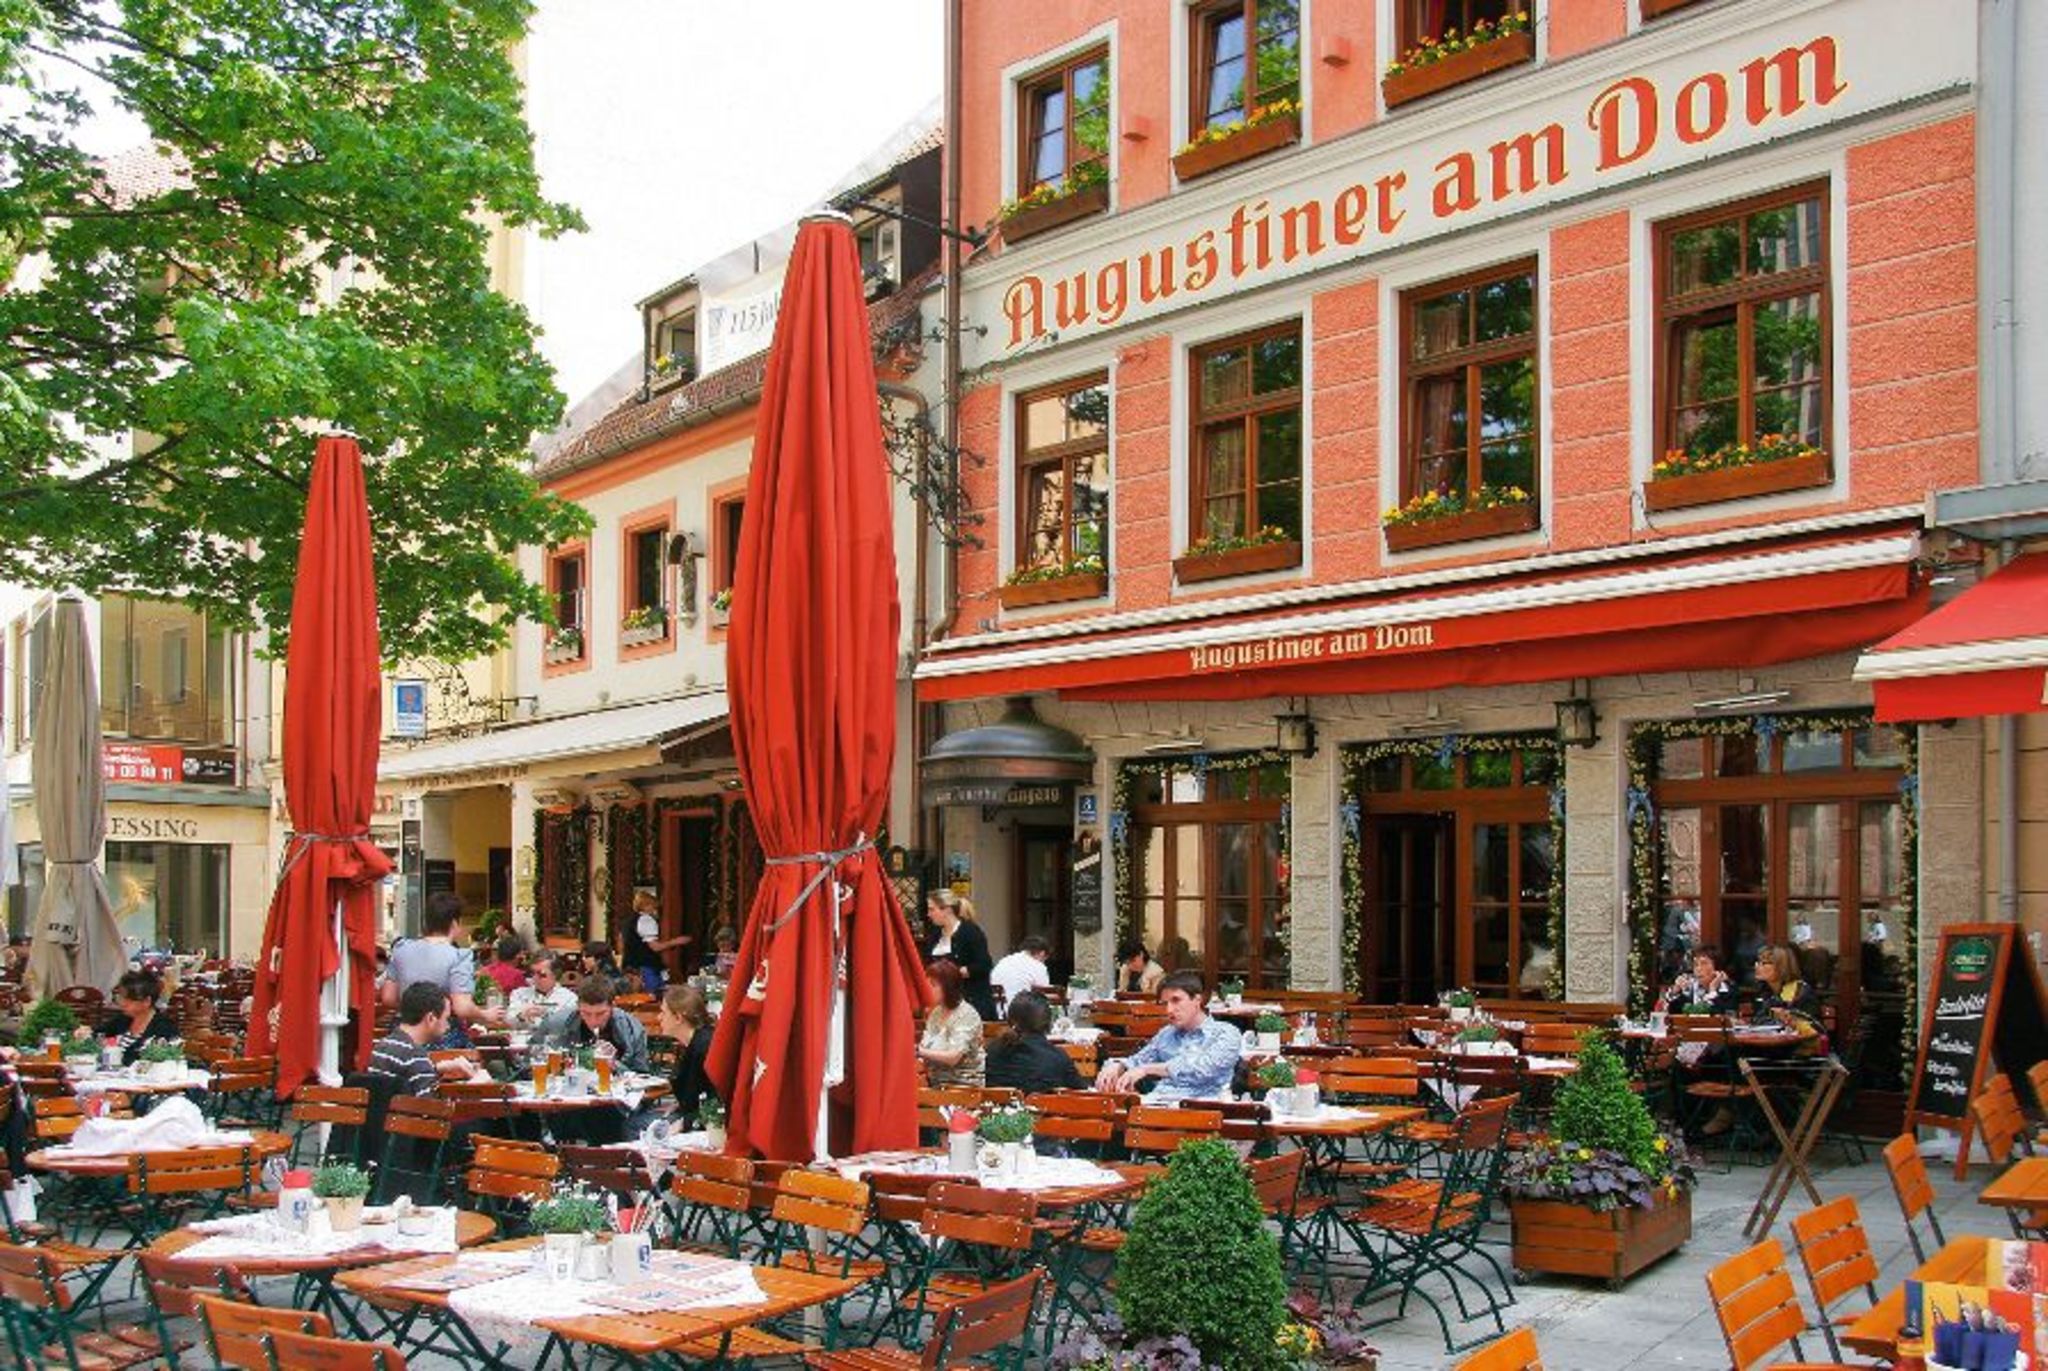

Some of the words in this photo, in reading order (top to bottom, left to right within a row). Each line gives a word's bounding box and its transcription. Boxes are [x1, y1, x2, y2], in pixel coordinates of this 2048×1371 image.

[1003, 170, 1407, 348] Augustiner
[1433, 121, 1569, 218] am
[1588, 35, 1848, 172] Dom
[1190, 636, 1324, 670] Augustiner
[1330, 631, 1368, 655] am
[1374, 624, 1434, 650] Dom
[111, 817, 198, 838] ESSING
